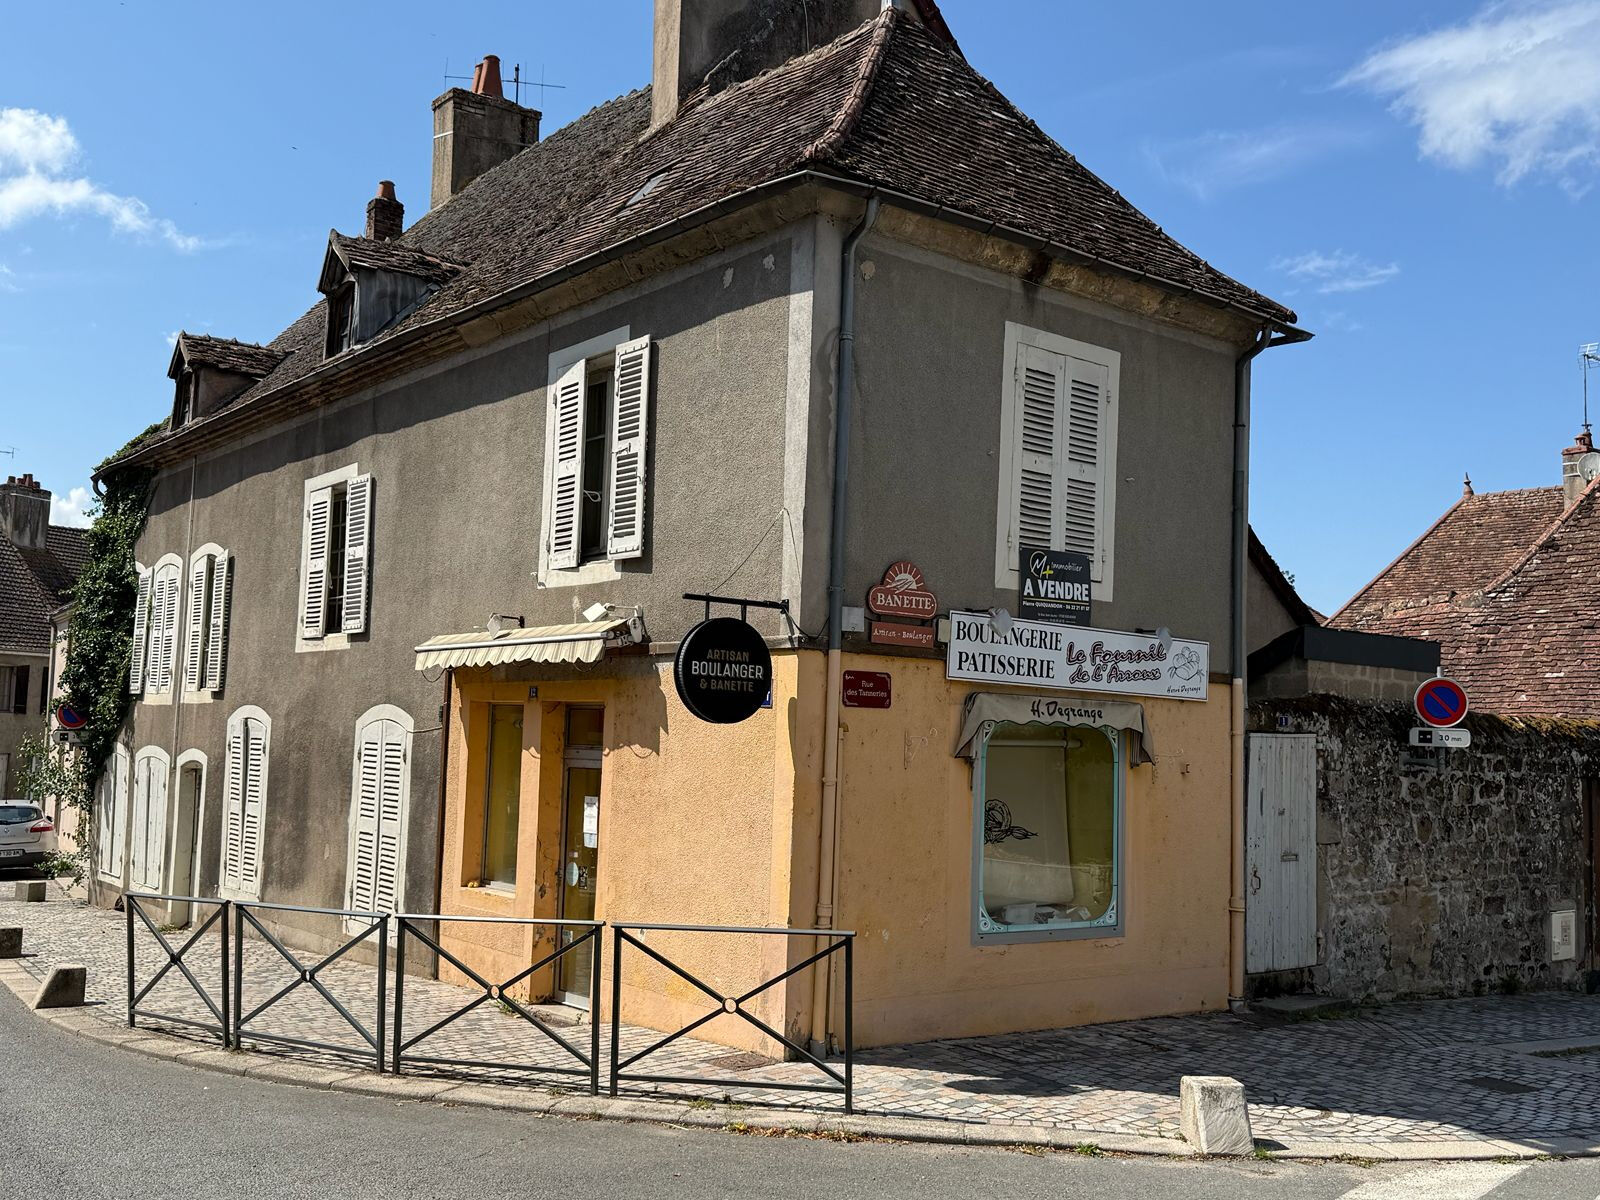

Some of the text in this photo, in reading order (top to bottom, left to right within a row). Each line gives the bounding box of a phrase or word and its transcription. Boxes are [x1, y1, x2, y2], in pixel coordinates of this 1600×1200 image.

[1023, 578, 1089, 601] A VENDRE
[877, 592, 932, 610] BANETTE
[902, 629, 933, 644] Boulanger
[706, 648, 750, 662] ARTISAN
[1066, 640, 1167, 667] Le Fournil
[691, 660, 764, 679] BOULANGER
[957, 651, 1055, 679] PATISSERIE
[1069, 664, 1090, 684] de
[699, 678, 754, 692] & BANETTE
[861, 680, 874, 688] Rue
[846, 688, 887, 698] des Tanneries
[1439, 734, 1450, 742] 30
